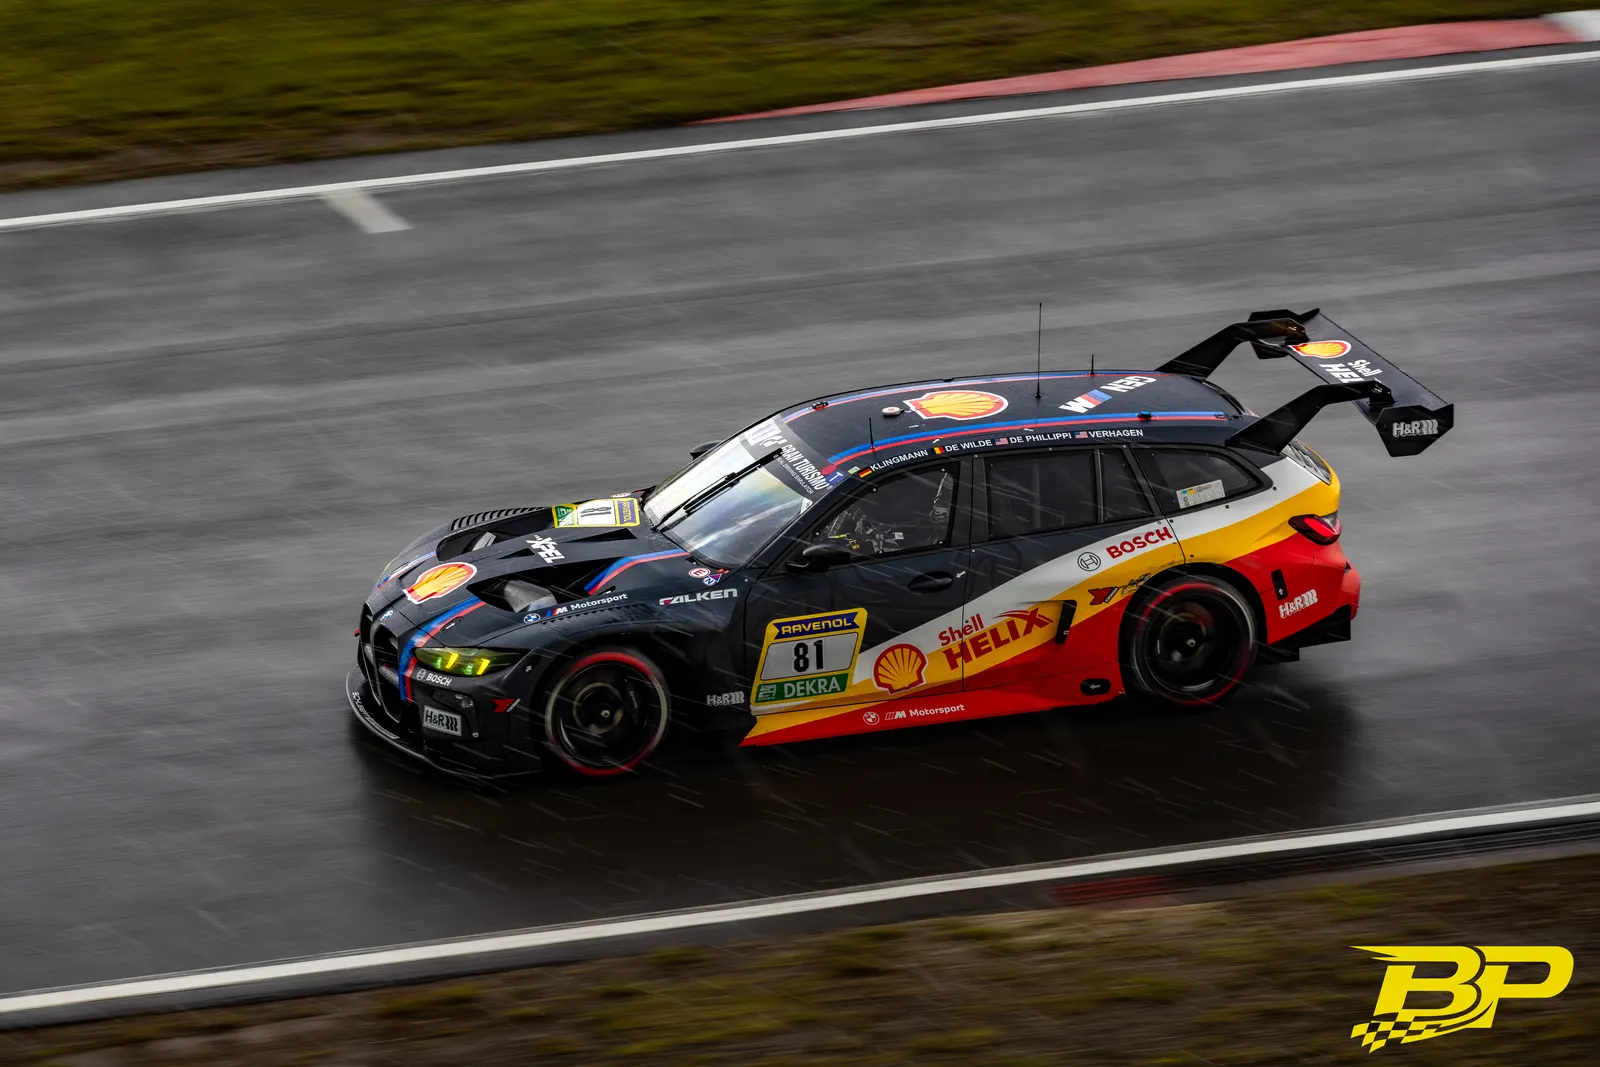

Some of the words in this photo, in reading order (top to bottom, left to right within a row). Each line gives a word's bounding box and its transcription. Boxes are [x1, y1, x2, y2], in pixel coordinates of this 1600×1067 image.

[1348, 359, 1383, 377] Shell
[1100, 376, 1157, 392] GEN
[1392, 420, 1427, 437] H&R
[870, 449, 929, 472] KLINGMANN
[960, 439, 993, 450] WILDE
[1009, 436, 1024, 444] DE
[1026, 432, 1072, 442] PHILLIPPI
[1088, 429, 1144, 438] VERHAGEN
[781, 444, 804, 467] GRAN
[796, 458, 831, 491] TURISMO
[525, 535, 566, 564] XPEL
[1106, 526, 1173, 559] BOSCH
[571, 593, 628, 611] Motorsport
[659, 588, 738, 606] FALKEN
[1279, 593, 1308, 619] H&R
[781, 618, 852, 635] RAVENOL
[938, 613, 985, 647] Shell
[942, 607, 1054, 671] HELIX
[793, 639, 824, 673] 81
[426, 673, 453, 687] BOSCH
[784, 676, 841, 699] DEKRA
[706, 692, 735, 707] H&R
[425, 710, 449, 727] H&R
[909, 703, 965, 718] Motorsport
